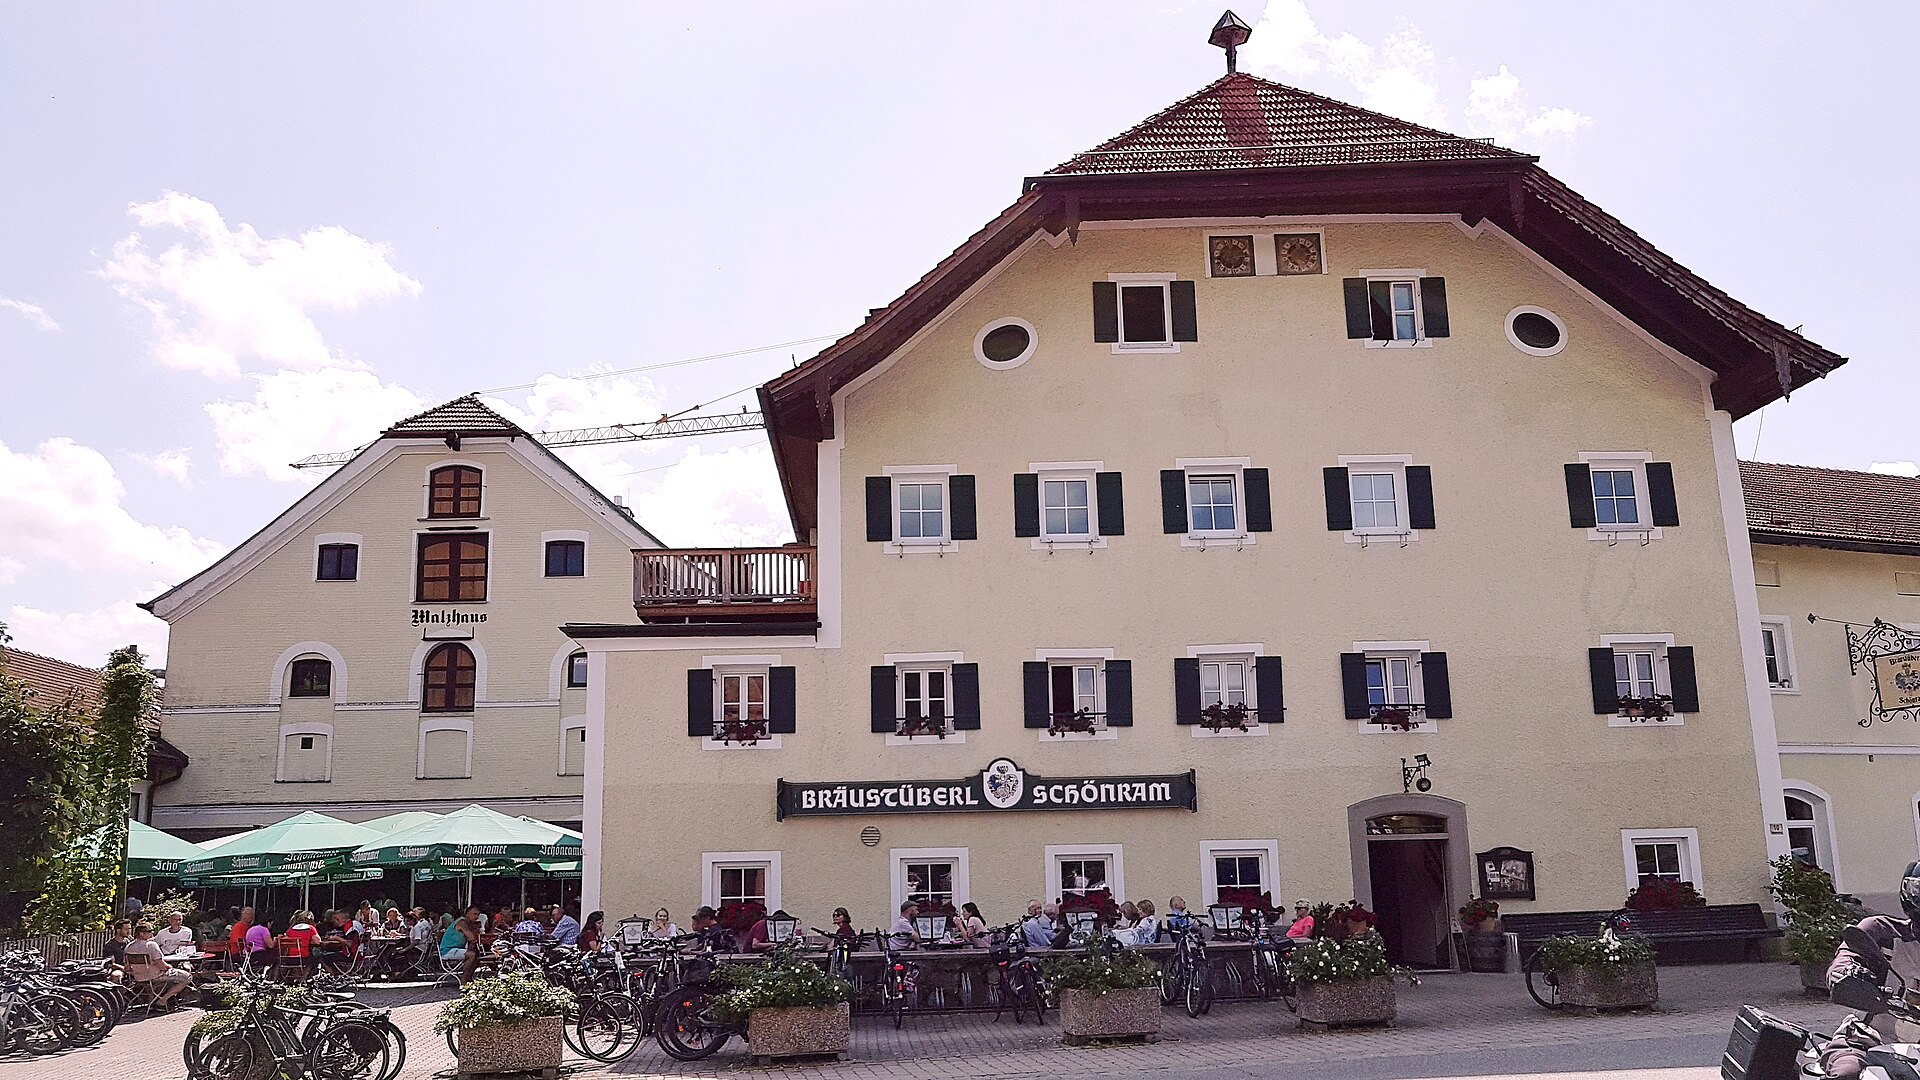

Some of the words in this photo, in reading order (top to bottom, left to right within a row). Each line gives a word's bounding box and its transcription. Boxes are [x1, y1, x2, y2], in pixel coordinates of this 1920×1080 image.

[411, 608, 488, 627] Malzhaus
[801, 784, 979, 809] BRÄUSTÜBERL
[1033, 780, 1171, 804] SCHÖNRAM
